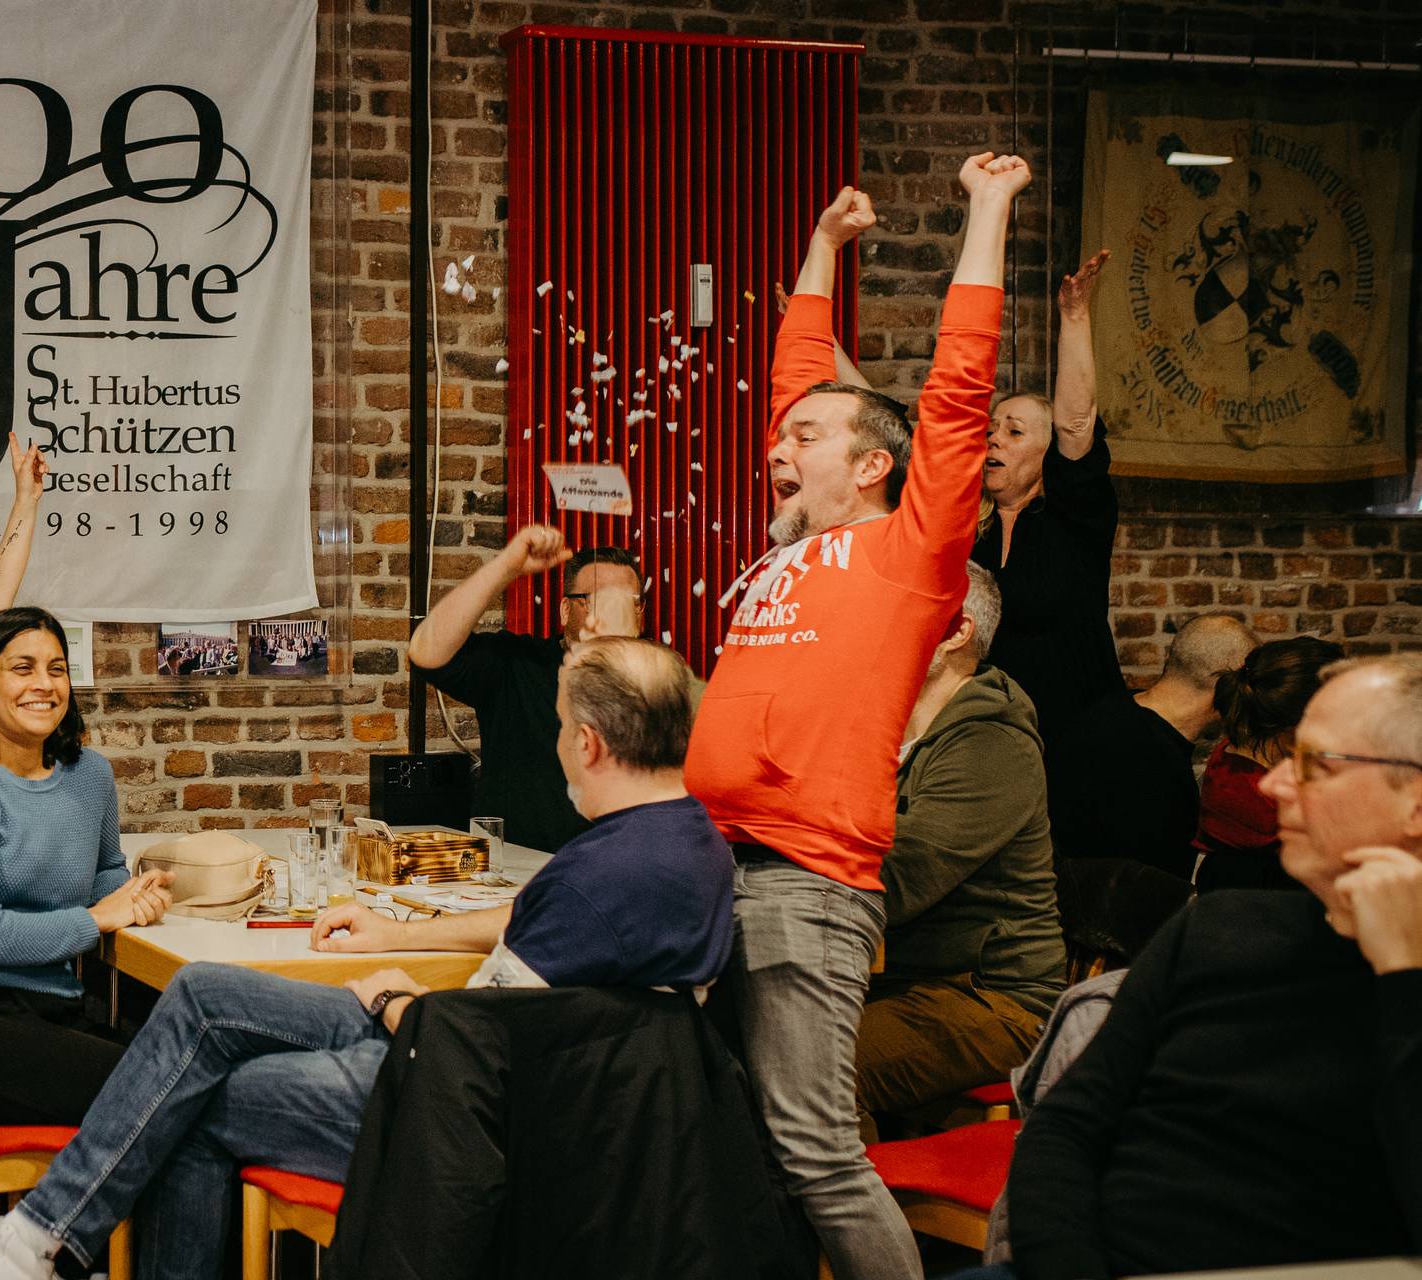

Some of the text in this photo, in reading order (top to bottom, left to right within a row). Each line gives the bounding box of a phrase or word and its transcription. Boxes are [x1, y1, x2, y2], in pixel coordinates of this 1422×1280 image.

[27, 343, 241, 406] St. Hubertus
[28, 396, 238, 458] Schützen
[738, 632, 788, 646] DENIM
[790, 629, 819, 643] CO.
